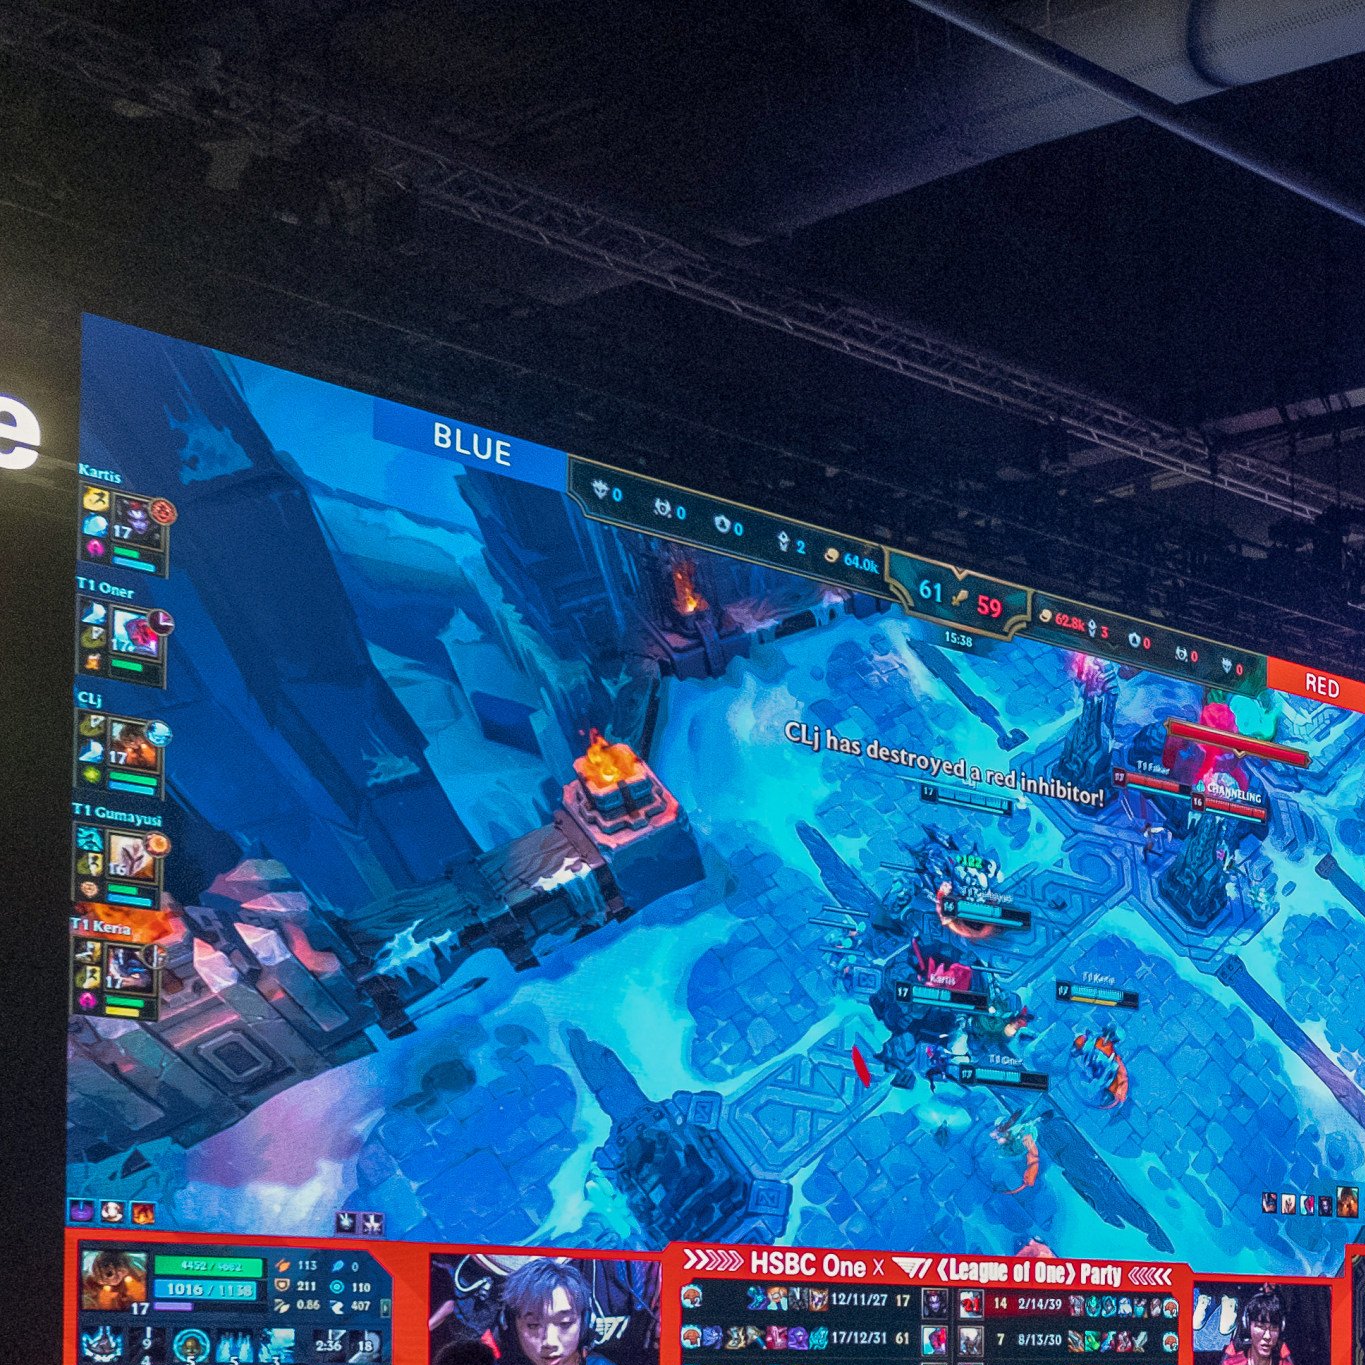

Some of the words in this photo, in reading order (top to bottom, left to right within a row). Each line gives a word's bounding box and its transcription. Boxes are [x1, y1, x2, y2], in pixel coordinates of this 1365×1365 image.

[433, 421, 512, 467] BLUE
[78, 463, 122, 485] Kartis
[113, 525, 133, 540] 17
[76, 577, 96, 592] T1
[99, 582, 135, 600] Oner
[612, 487, 623, 503] 0
[676, 506, 687, 521] 0
[734, 522, 744, 538] 0
[796, 540, 806, 554] 2
[844, 552, 880, 575] 64.0k
[918, 579, 943, 603] 61
[976, 595, 1003, 618] 59
[1054, 611, 1086, 634] 62.8k
[1101, 625, 1110, 639] 3
[1143, 636, 1151, 650] 0
[1190, 650, 1199, 664] 0
[1235, 663, 1244, 677] 0
[1305, 672, 1341, 699] RED
[944, 630, 974, 649] 15:38
[77, 691, 103, 709] CLj
[109, 751, 128, 766] 17
[784, 721, 820, 753] CLj
[825, 730, 861, 756] has
[866, 738, 966, 778] destroyed
[970, 767, 981, 781] a
[986, 769, 1016, 789] red
[1021, 771, 1105, 808] inhibitor!
[923, 786, 934, 796] 17
[1207, 782, 1262, 804] CHANNELING
[72, 803, 92, 817] T1
[94, 806, 163, 828] Gumayusi
[108, 863, 127, 877] 16
[70, 917, 90, 932] T1
[106, 976, 123, 990] 17
[298, 1260, 318, 1272] 113
[351, 1261, 359, 1273] 0
[751, 1251, 817, 1277] HSBC
[822, 1253, 867, 1278] One
[1013, 1261, 1031, 1283] of
[1080, 1263, 1122, 1288] Party
[167, 1283, 203, 1297] 1016
[296, 1281, 317, 1293] 211
[352, 1283, 371, 1294] 110
[296, 1300, 321, 1311] 0.86
[351, 1301, 371, 1312] 407
[831, 1293, 888, 1307] 12/11/27
[895, 1294, 910, 1307] 17
[993, 1296, 1008, 1309] 14
[1018, 1297, 1063, 1310] 2/14/39
[131, 1303, 150, 1316] 17
[831, 1331, 888, 1345] 17/12/31
[895, 1332, 910, 1345] 61
[997, 1333, 1005, 1346] 7
[1017, 1333, 1063, 1346] 8/13/30
[315, 1340, 342, 1352] 2:36
[358, 1340, 373, 1352] 18
